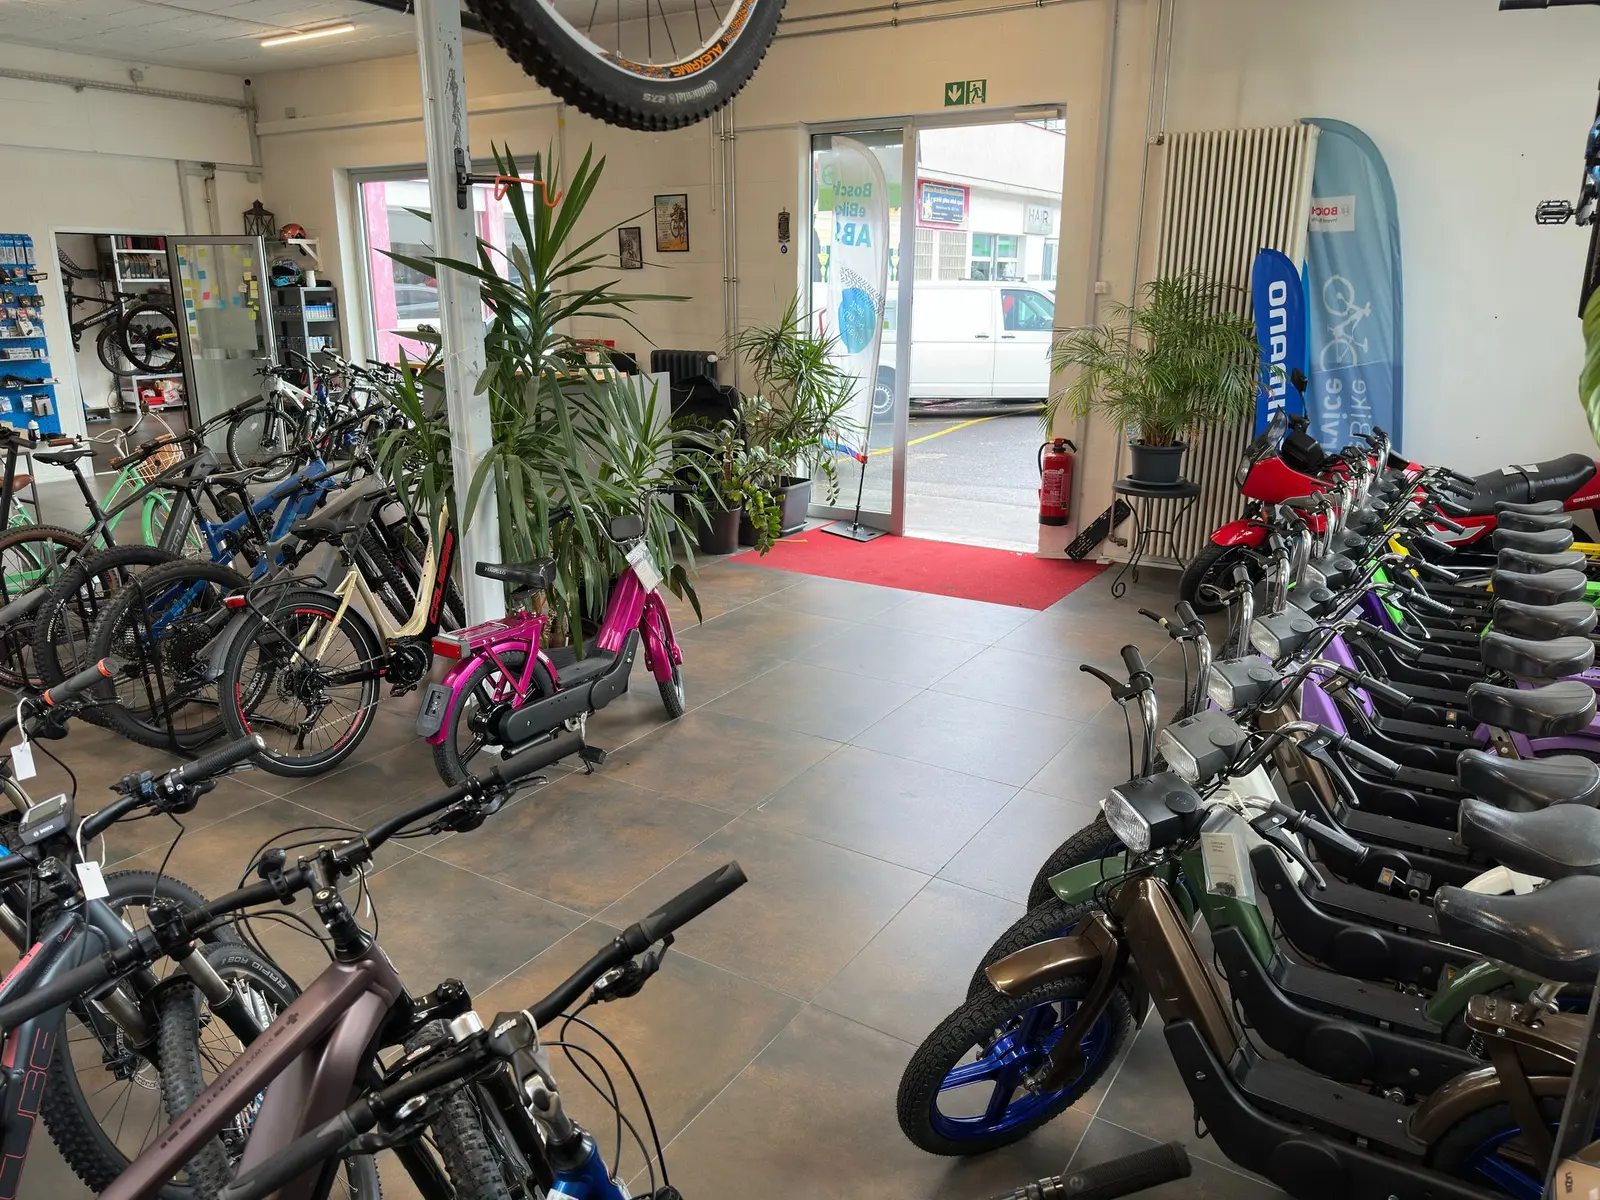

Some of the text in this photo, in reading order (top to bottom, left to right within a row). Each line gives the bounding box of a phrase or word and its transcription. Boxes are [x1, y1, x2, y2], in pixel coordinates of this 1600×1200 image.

[670, 43, 723, 77] ALEXRIMS
[1028, 208, 1049, 224] HAIR
[1267, 280, 1287, 451] IMANO
[1320, 378, 1347, 456] rvice
[251, 961, 287, 990] RAPID
